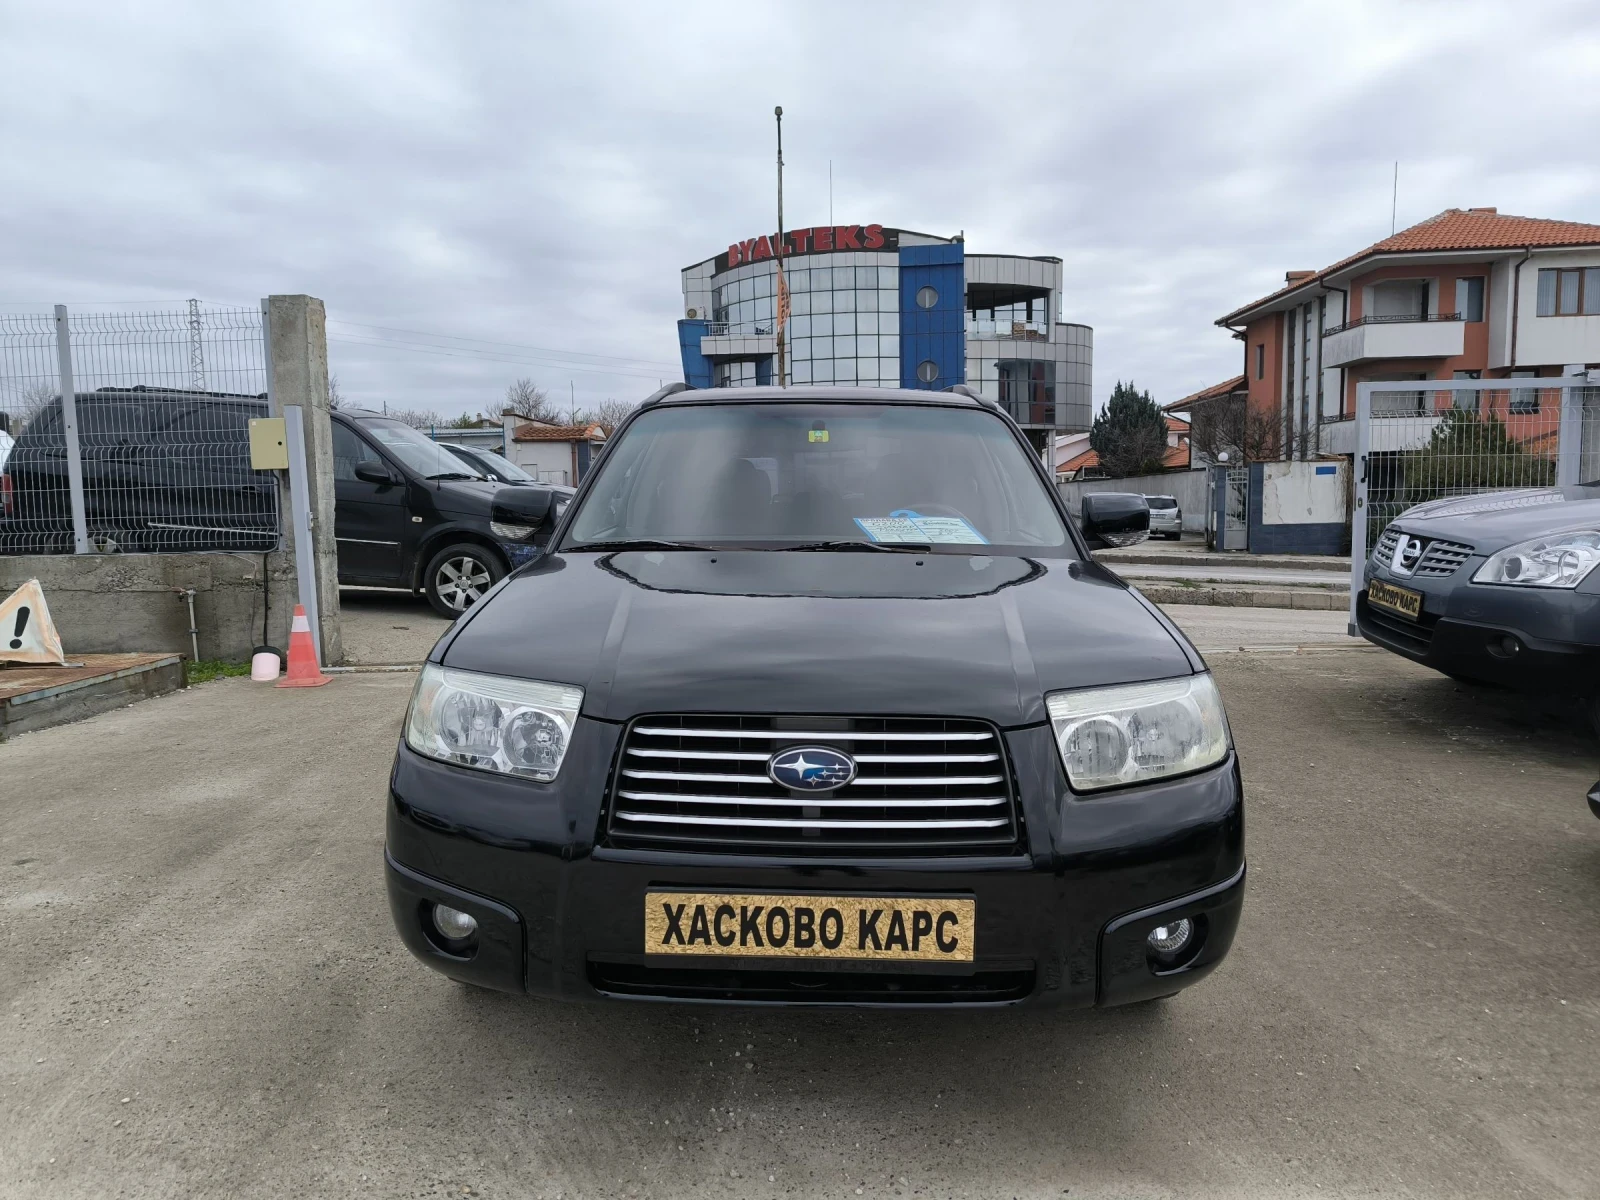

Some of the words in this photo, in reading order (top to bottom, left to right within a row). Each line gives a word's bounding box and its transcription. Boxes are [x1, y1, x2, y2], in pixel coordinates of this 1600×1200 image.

[728, 224, 885, 268] BYALTEKS
[1370, 582, 1399, 607] ХАСКОВО
[1399, 592, 1418, 613] КАРС
[661, 902, 844, 950] ХАСКОВО
[858, 909, 959, 953] КАРС
